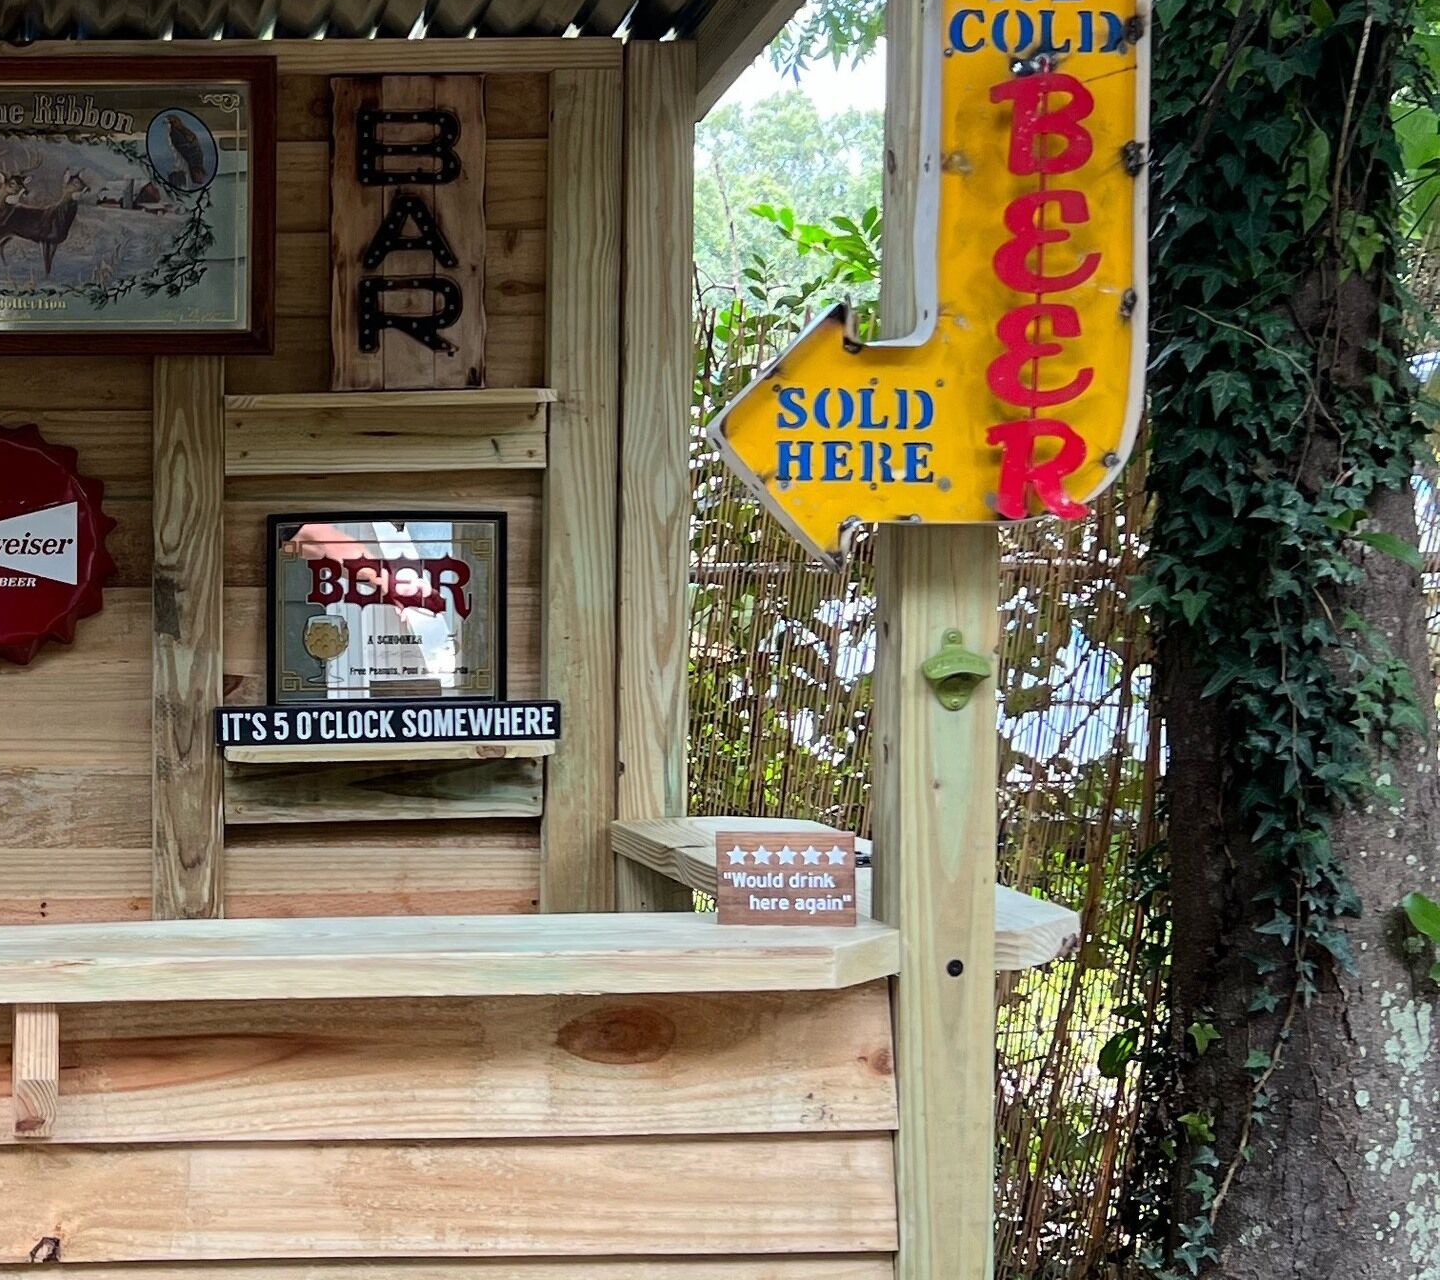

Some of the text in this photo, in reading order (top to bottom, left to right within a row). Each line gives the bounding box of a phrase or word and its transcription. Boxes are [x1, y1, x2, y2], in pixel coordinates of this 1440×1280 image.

[949, 8, 1126, 54] COLD
[33, 93, 135, 134] Ribbon
[358, 109, 463, 353] BAR
[0, 298, 67, 310] Collection
[986, 71, 1102, 520] BEER
[776, 387, 935, 430] SOLD
[775, 439, 935, 483] HERE
[307, 553, 472, 620] BEER
[367, 635, 373, 645] A
[222, 706, 555, 741] IT'S 5 O'CLOCK SOMEWHERE
[723, 872, 836, 889] "Would drink
[749, 894, 852, 914] here again"
